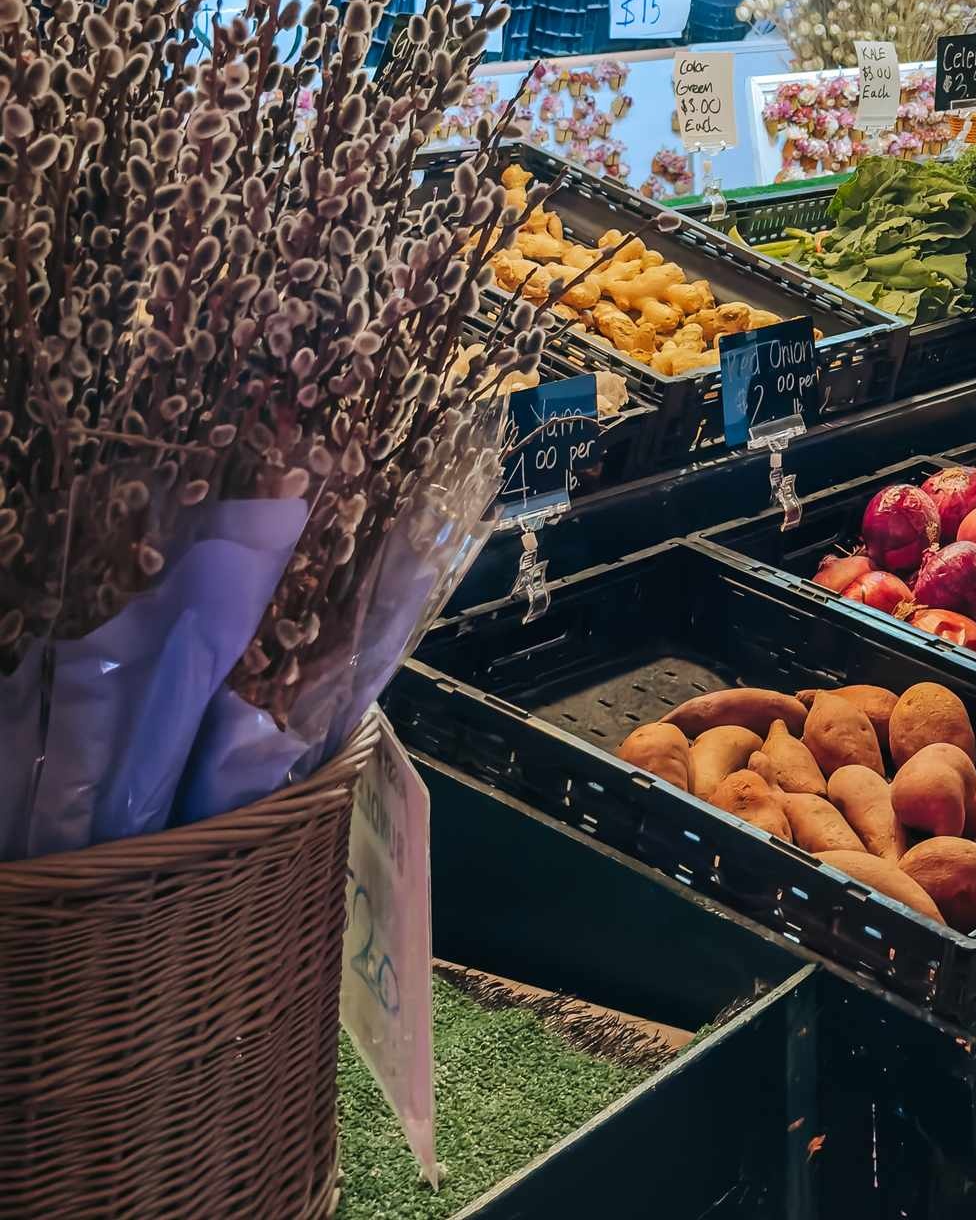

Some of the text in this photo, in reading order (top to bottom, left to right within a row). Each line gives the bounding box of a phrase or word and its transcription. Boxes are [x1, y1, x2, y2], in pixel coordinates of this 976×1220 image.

[675, 79, 713, 96] Green
[862, 84, 891, 100] Each
[799, 374, 817, 397] per
[569, 438, 597, 471] per
